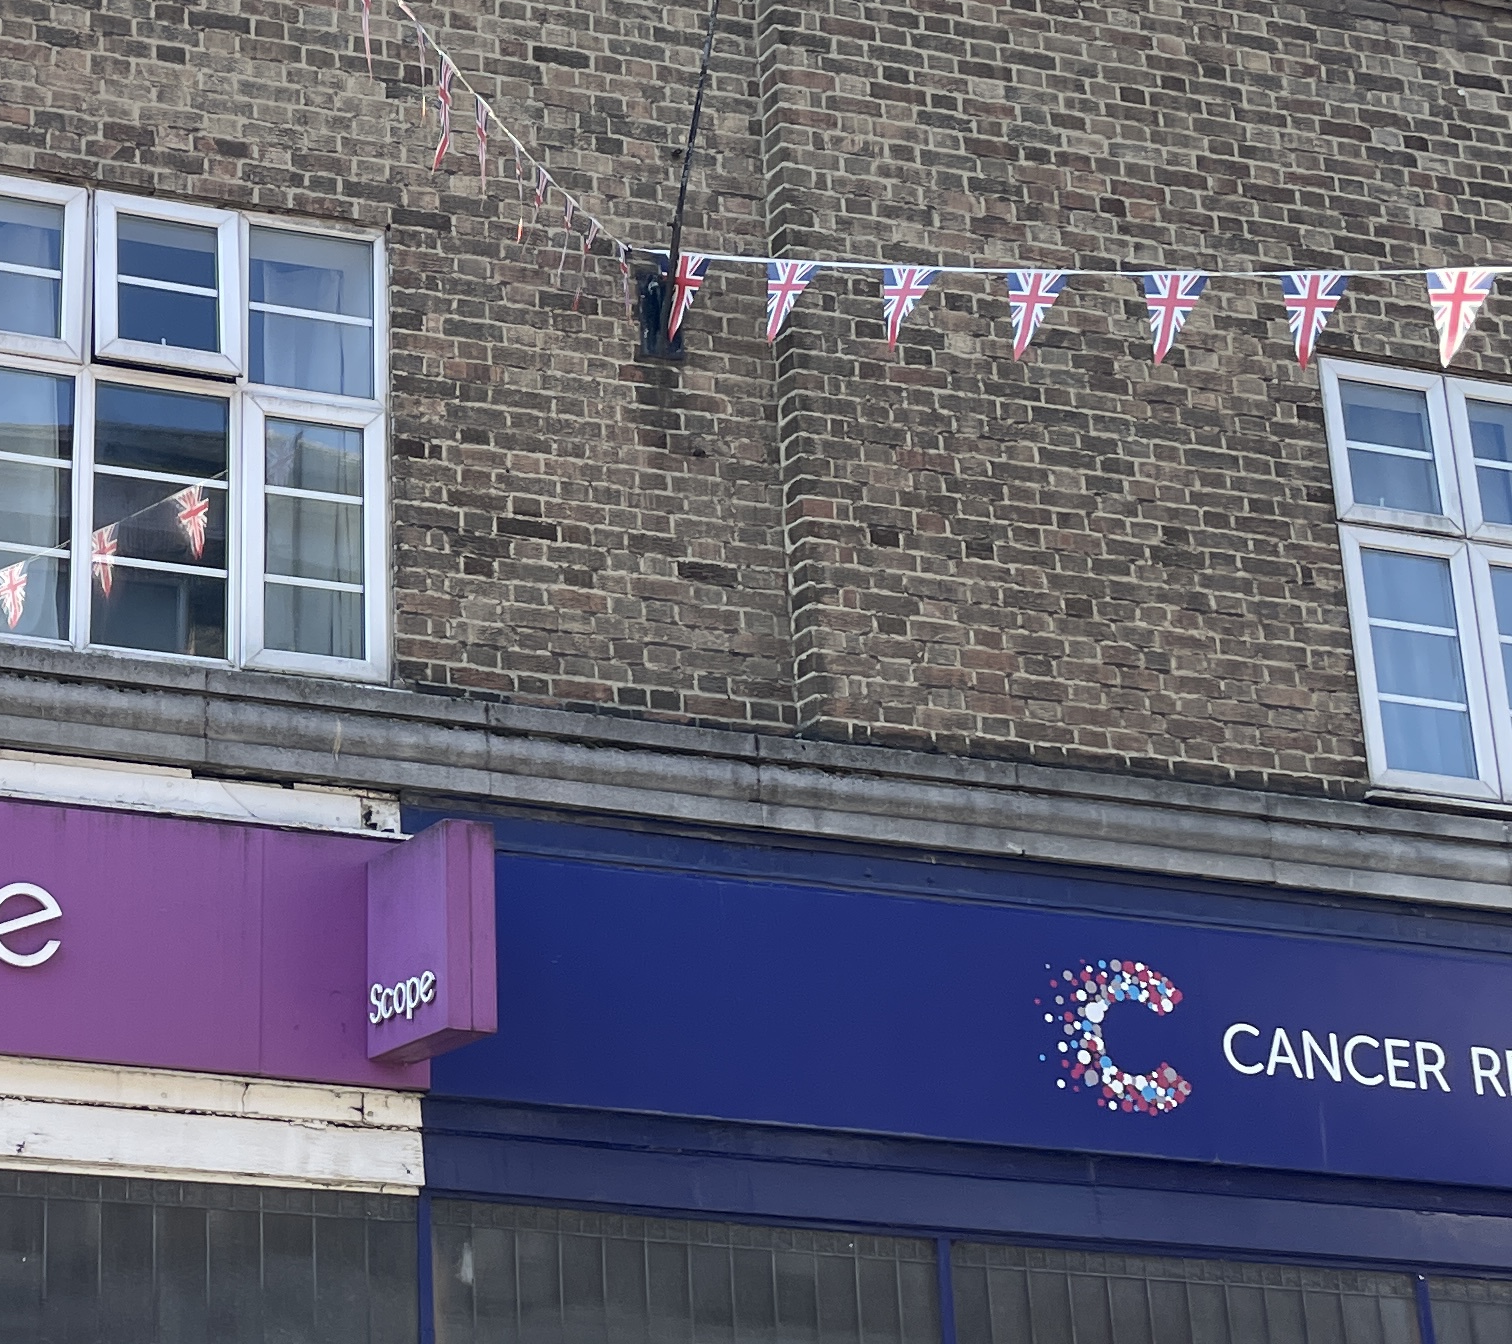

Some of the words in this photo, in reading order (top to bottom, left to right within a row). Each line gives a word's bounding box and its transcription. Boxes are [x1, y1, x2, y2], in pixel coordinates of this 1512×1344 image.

[369, 970, 436, 1024] Scope
[1223, 1023, 1451, 1093] CANCER
[1470, 1046, 1512, 1098] R
